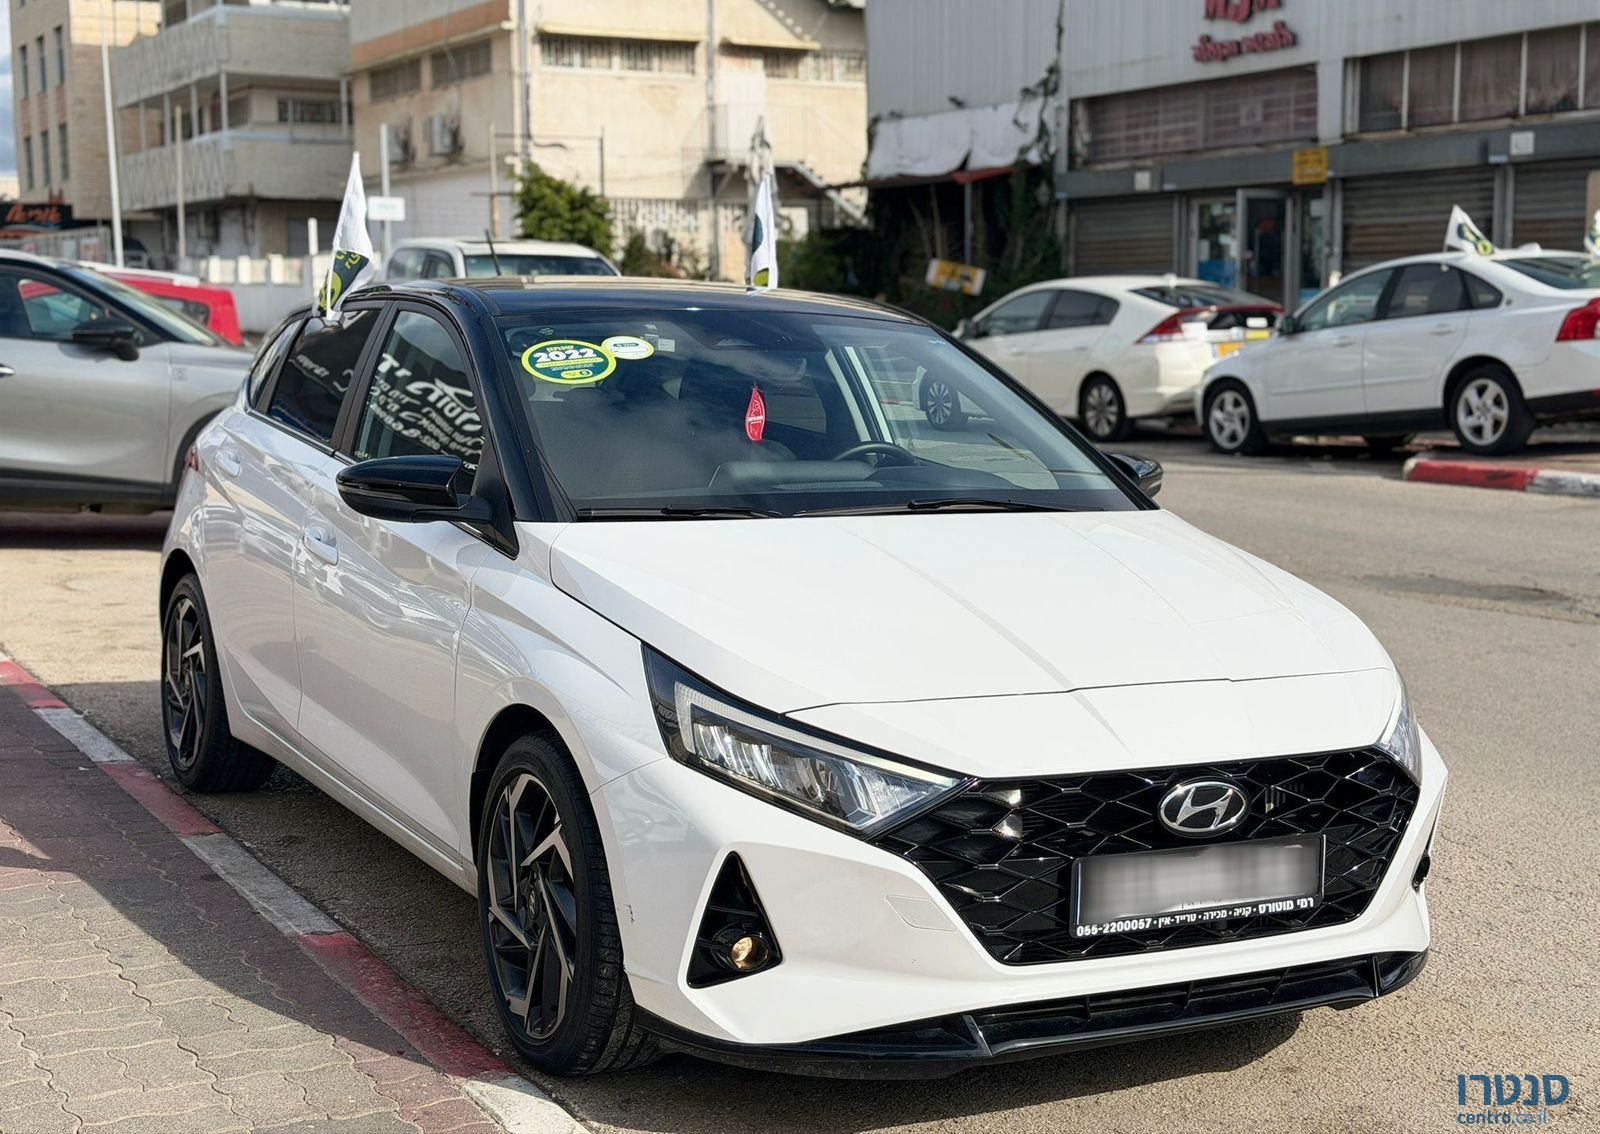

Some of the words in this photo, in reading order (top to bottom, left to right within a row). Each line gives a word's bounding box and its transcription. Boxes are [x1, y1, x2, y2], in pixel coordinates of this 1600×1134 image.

[533, 347, 597, 363] 2022
[1258, 899, 1294, 914] מוטורס
[1296, 897, 1314, 909] רמי
[1203, 909, 1227, 920] מכירה
[1233, 906, 1252, 918] קניה
[1076, 917, 1152, 937] 055-2200057
[1158, 913, 1197, 929] טרייד-אין
